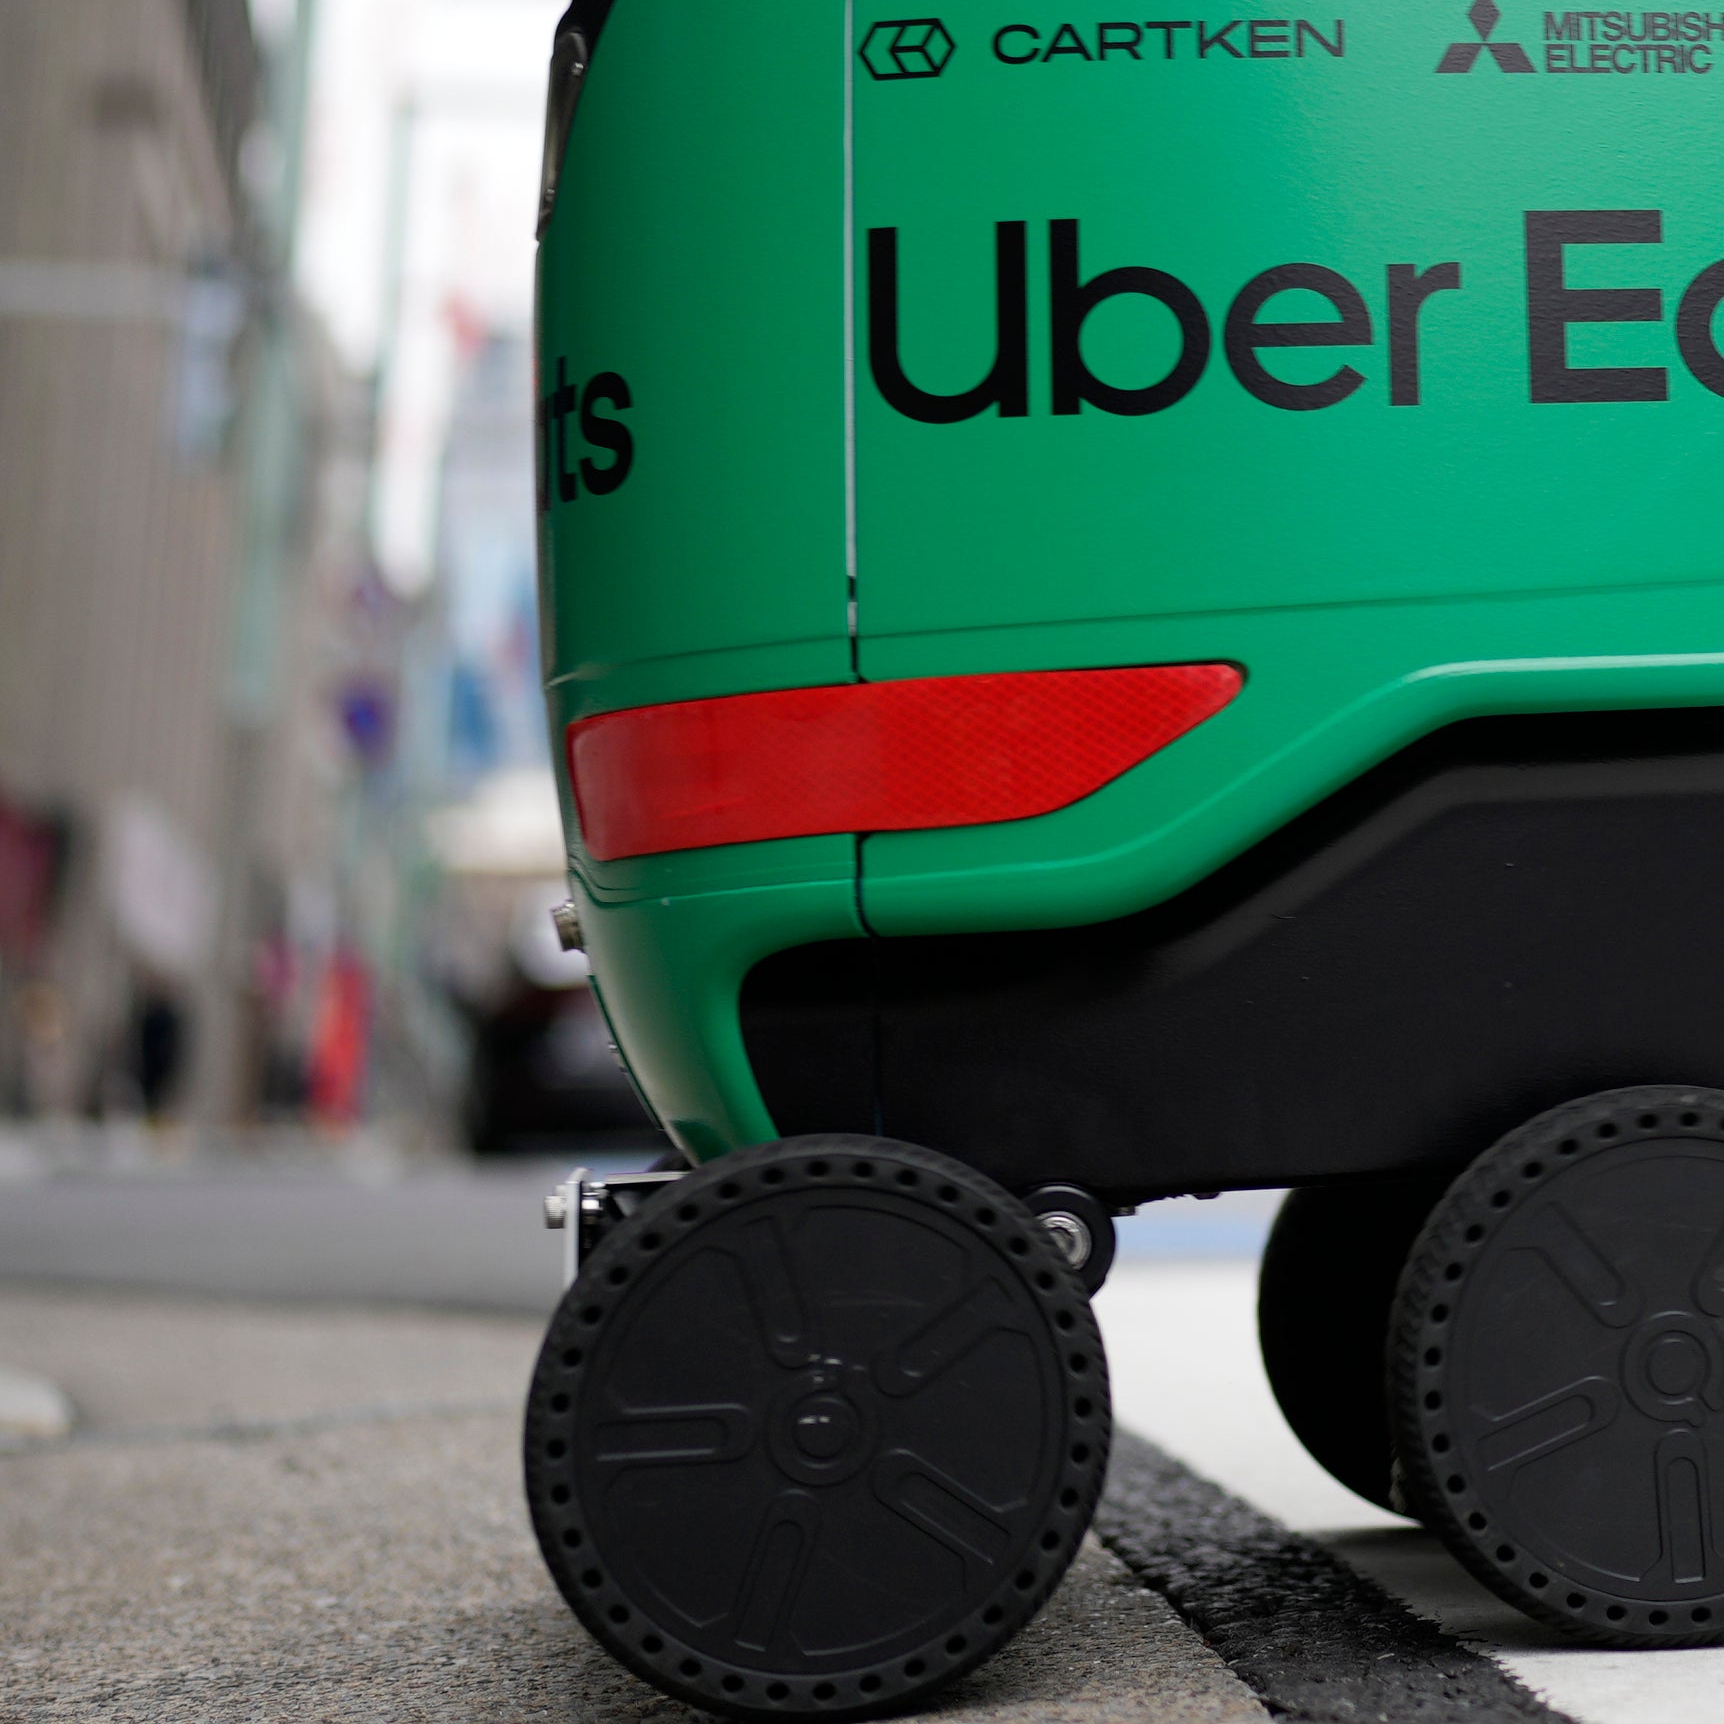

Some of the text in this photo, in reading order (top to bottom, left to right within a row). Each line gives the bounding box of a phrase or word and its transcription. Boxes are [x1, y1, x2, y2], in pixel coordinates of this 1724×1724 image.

[991, 19, 1343, 65] CARTKEN
[1545, 43, 1713, 74] ELECTRIC
[866, 218, 1461, 425] Uber
[541, 356, 635, 511] ts
